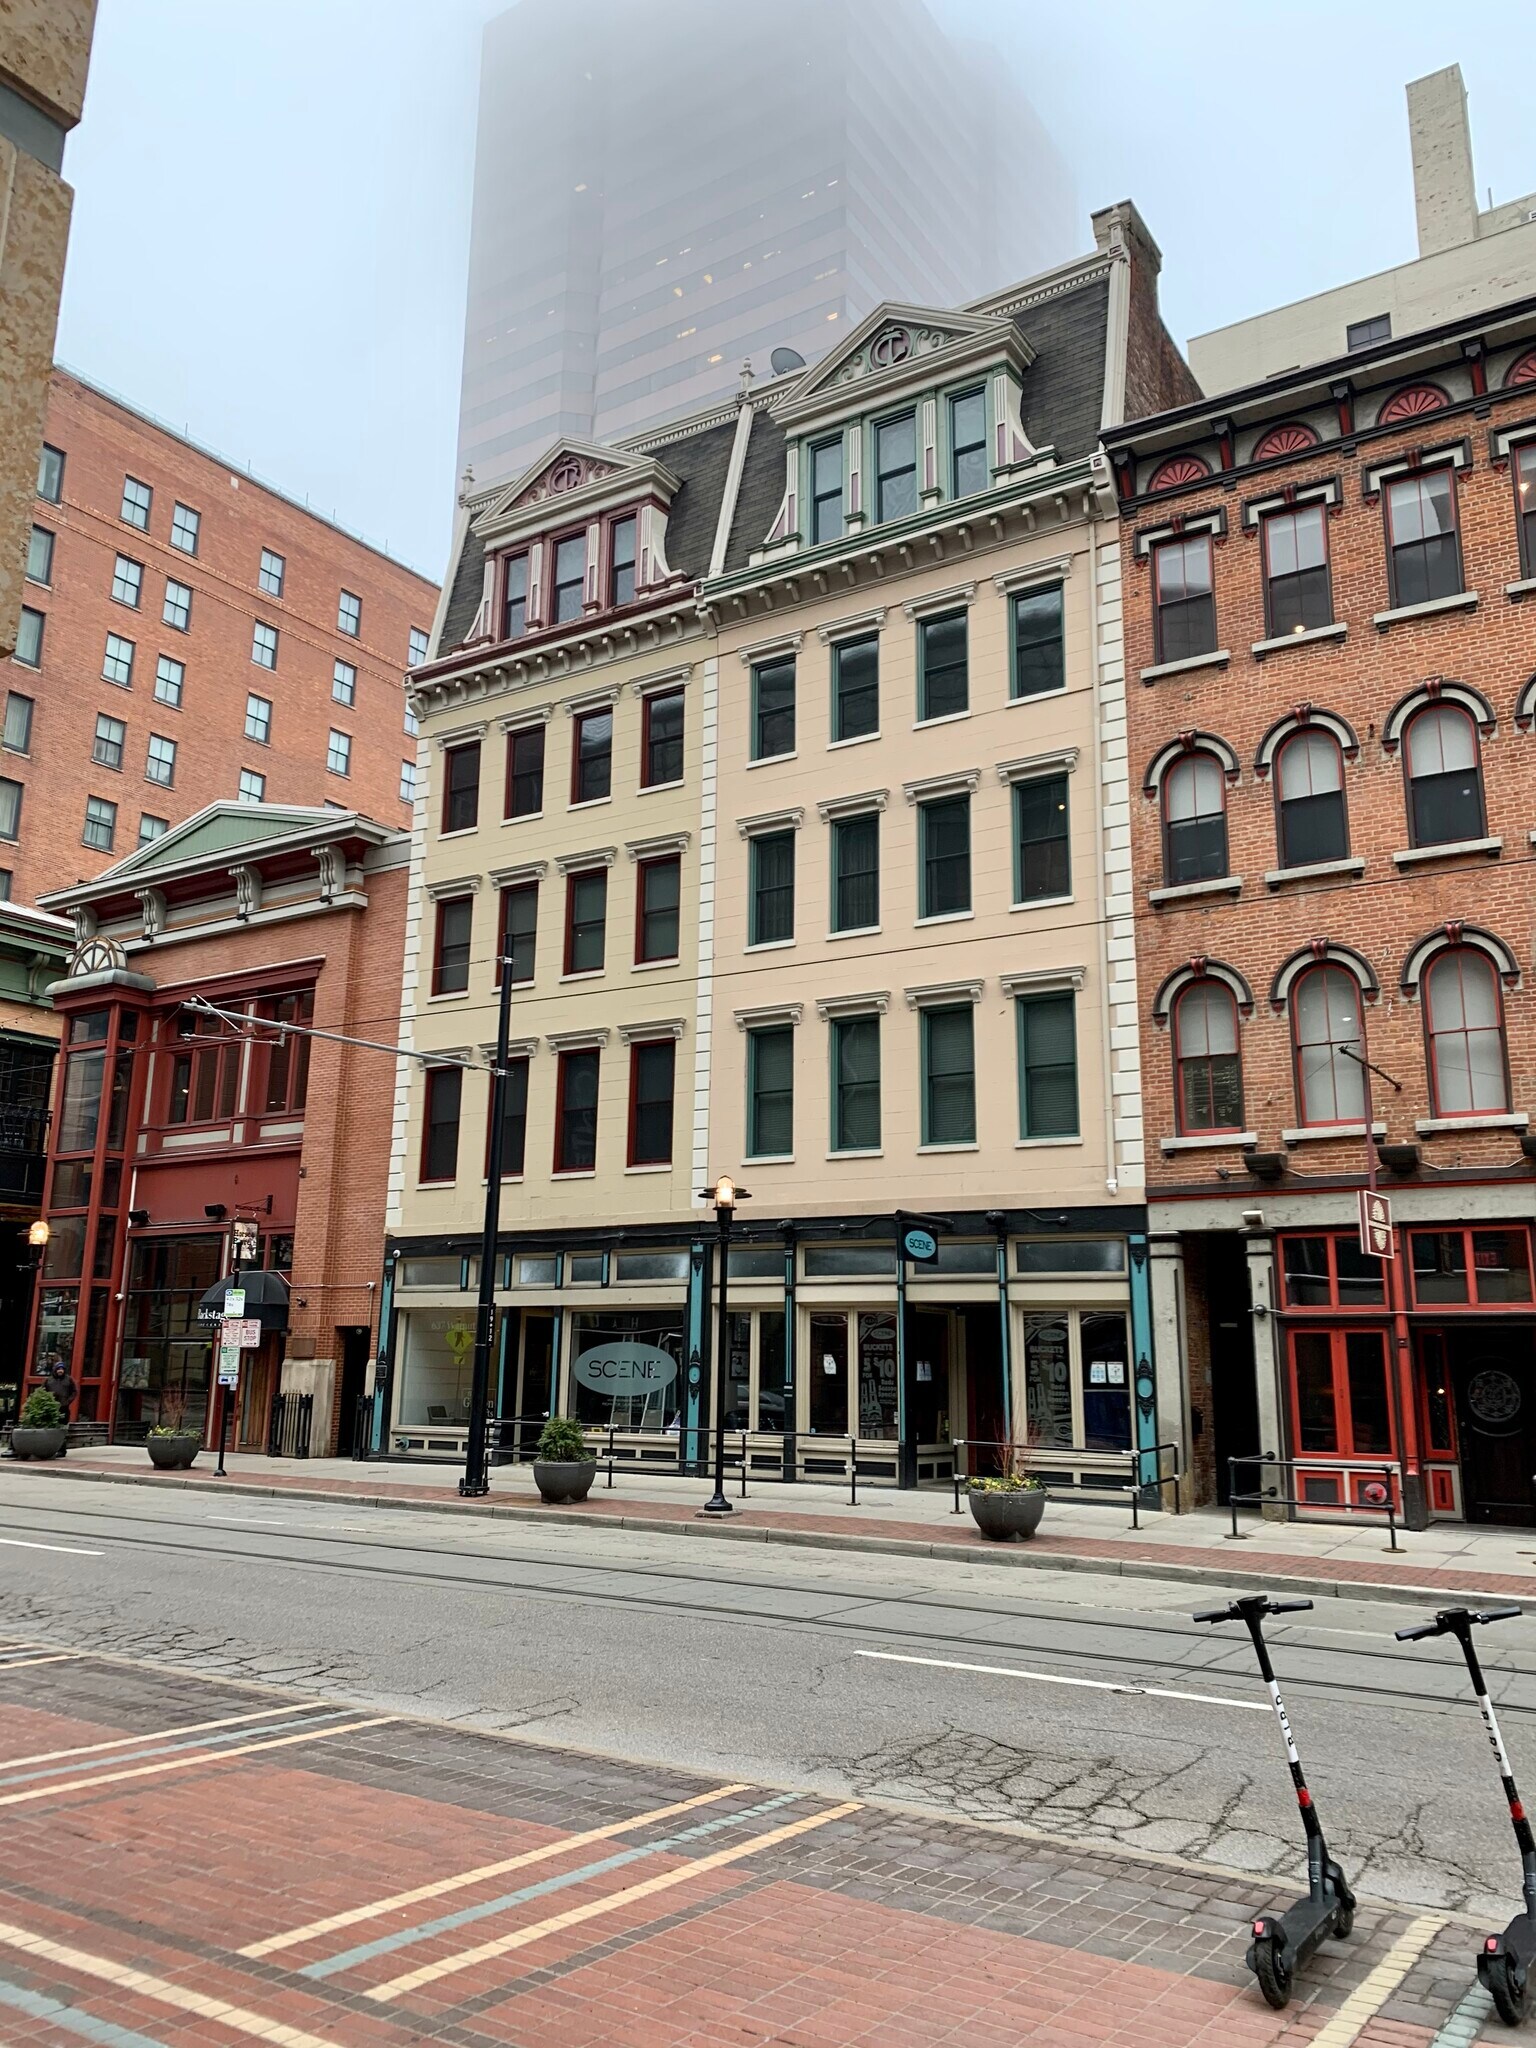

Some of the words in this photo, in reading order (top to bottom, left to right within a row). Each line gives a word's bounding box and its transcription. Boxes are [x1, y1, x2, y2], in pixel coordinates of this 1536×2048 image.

[909, 1238, 932, 1251] SCENE
[588, 1360, 661, 1379] SCENE
[863, 1357, 871, 1372] 5
[873, 1357, 896, 1378] $10
[1030, 1360, 1039, 1375] 5
